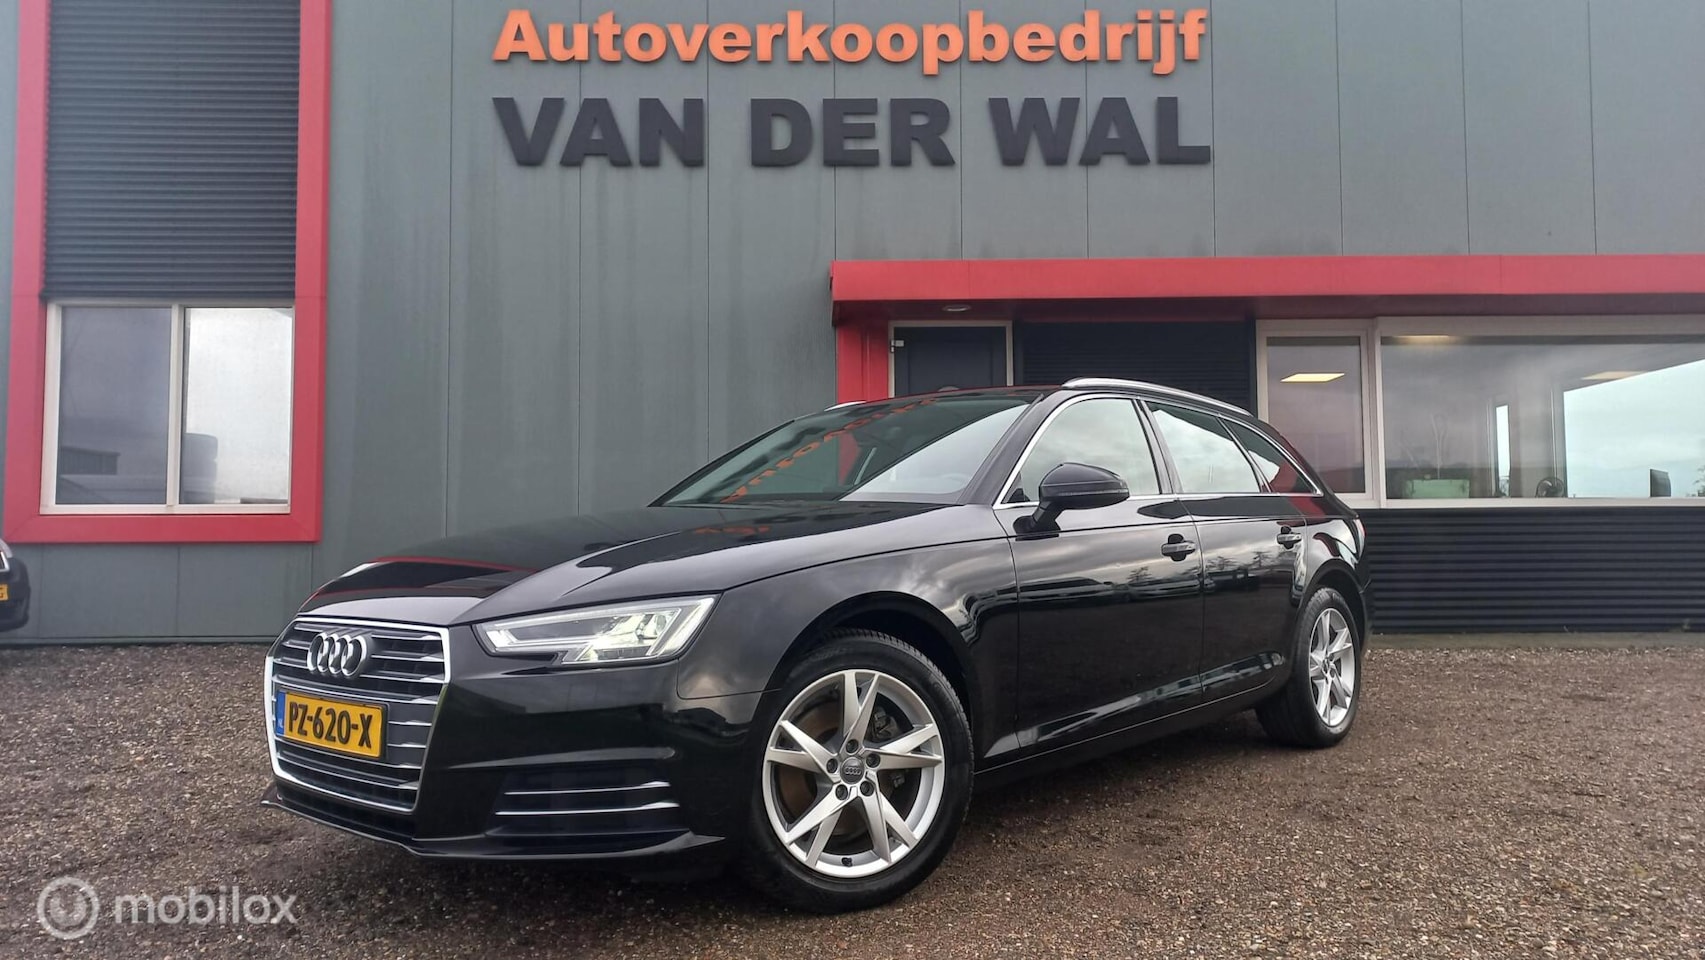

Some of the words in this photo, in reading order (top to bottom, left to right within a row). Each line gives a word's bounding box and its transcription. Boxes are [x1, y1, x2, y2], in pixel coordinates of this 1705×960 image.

[492, 9, 1209, 76] Autoverkoopbedrijf
[492, 97, 705, 168] VAN
[751, 98, 956, 168] DER
[988, 96, 1212, 166] WAL
[288, 701, 374, 749] PZ-620-X
